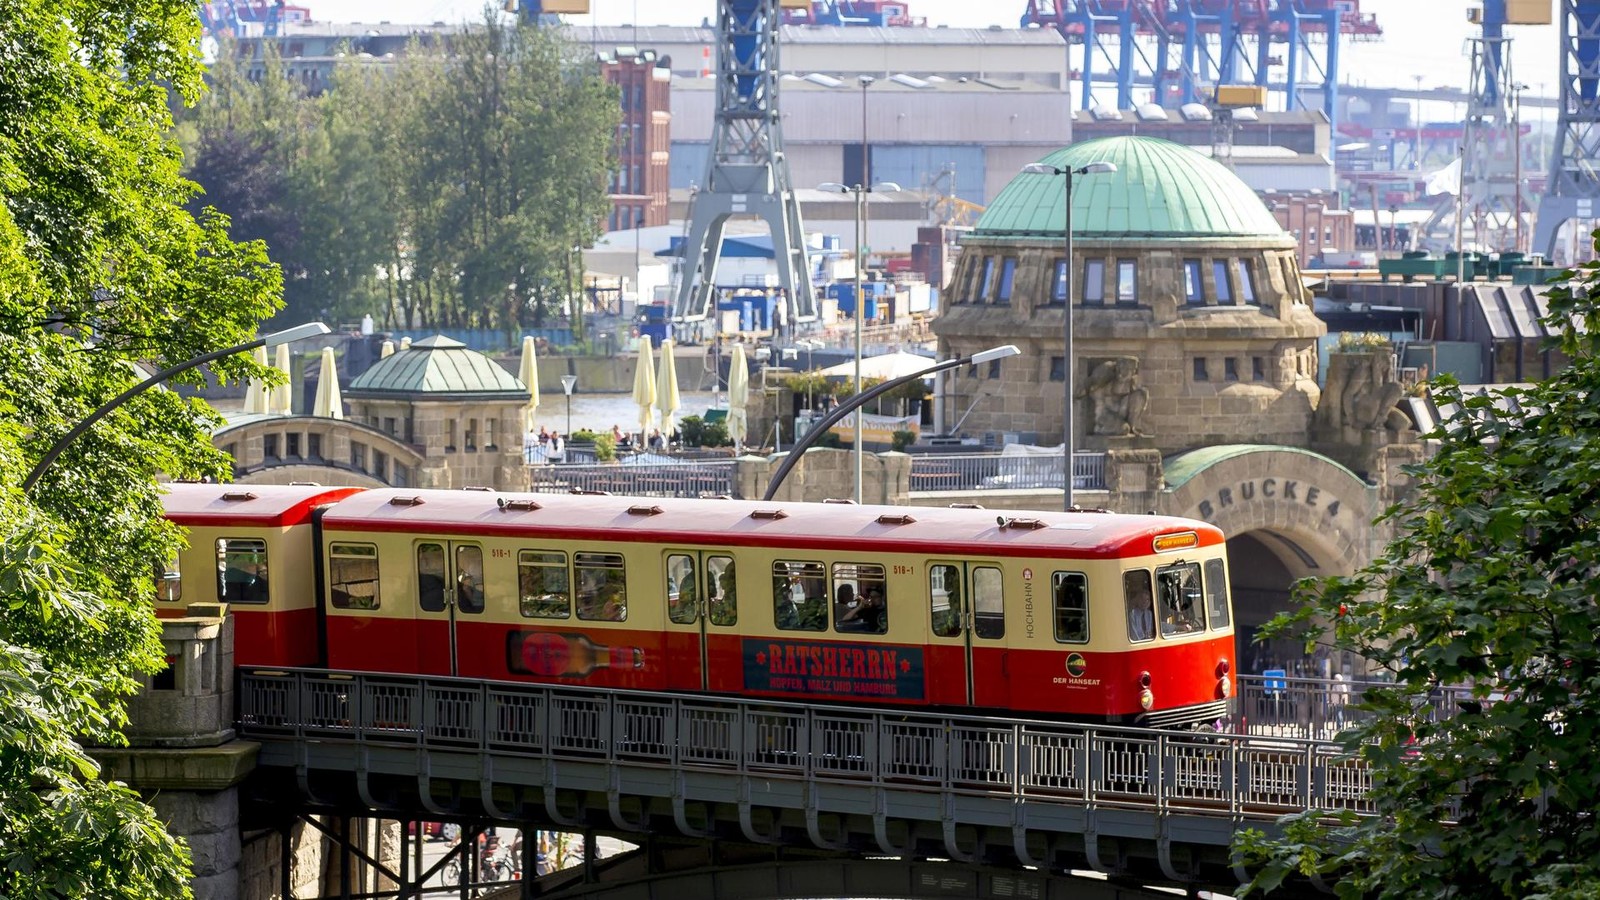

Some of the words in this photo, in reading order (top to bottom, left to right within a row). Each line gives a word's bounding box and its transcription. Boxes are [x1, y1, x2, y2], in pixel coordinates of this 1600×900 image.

[1327, 500, 1341, 517] 4
[893, 565, 914, 575] 516-1
[1024, 582, 1034, 639] HOCHBAHN
[768, 643, 897, 680] RATSHERRN
[770, 677, 806, 691] HOPFEN,
[807, 679, 832, 692] MALZ
[833, 680, 851, 693] UND
[853, 681, 897, 695] HAMBURG
